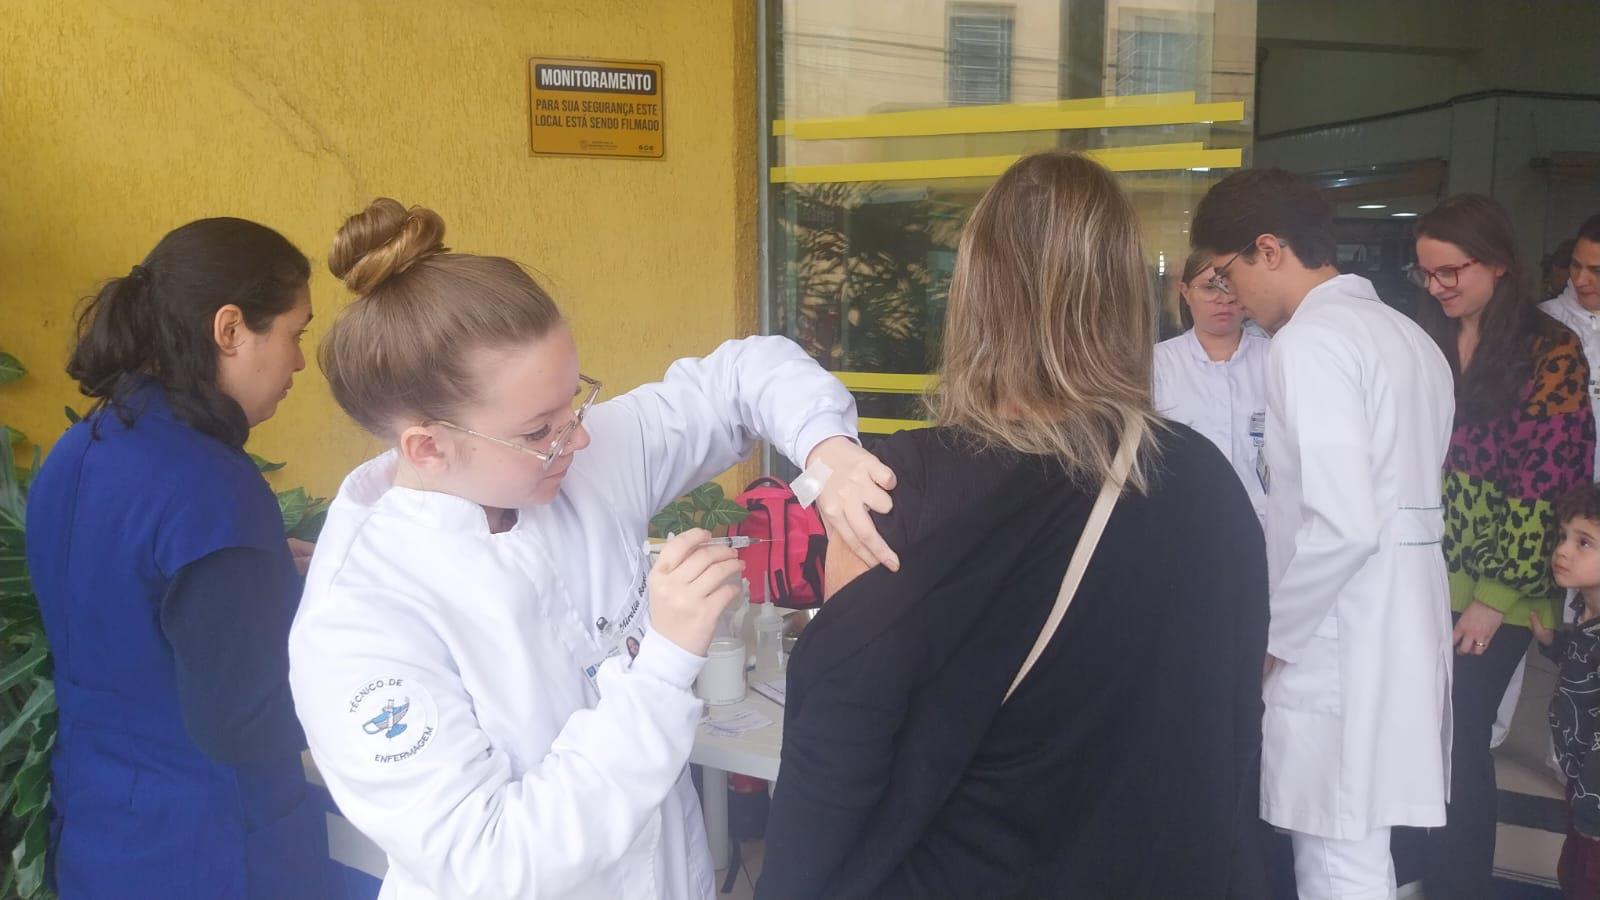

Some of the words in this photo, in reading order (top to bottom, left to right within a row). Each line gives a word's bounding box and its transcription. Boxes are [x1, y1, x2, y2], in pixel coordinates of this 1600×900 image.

[540, 68, 652, 91] MONITORAMENTO
[535, 98, 560, 111] PARA
[561, 100, 580, 113] SUA
[582, 101, 634, 117] SEGURANÇA
[636, 104, 657, 116] ESTE
[535, 115, 563, 128] LOCAL
[565, 115, 588, 129] ESTÁ
[590, 117, 619, 129] SENDO
[621, 119, 659, 132] FILMADO
[388, 678, 403, 687] DE
[374, 726, 433, 763] ENFERMAGEM
